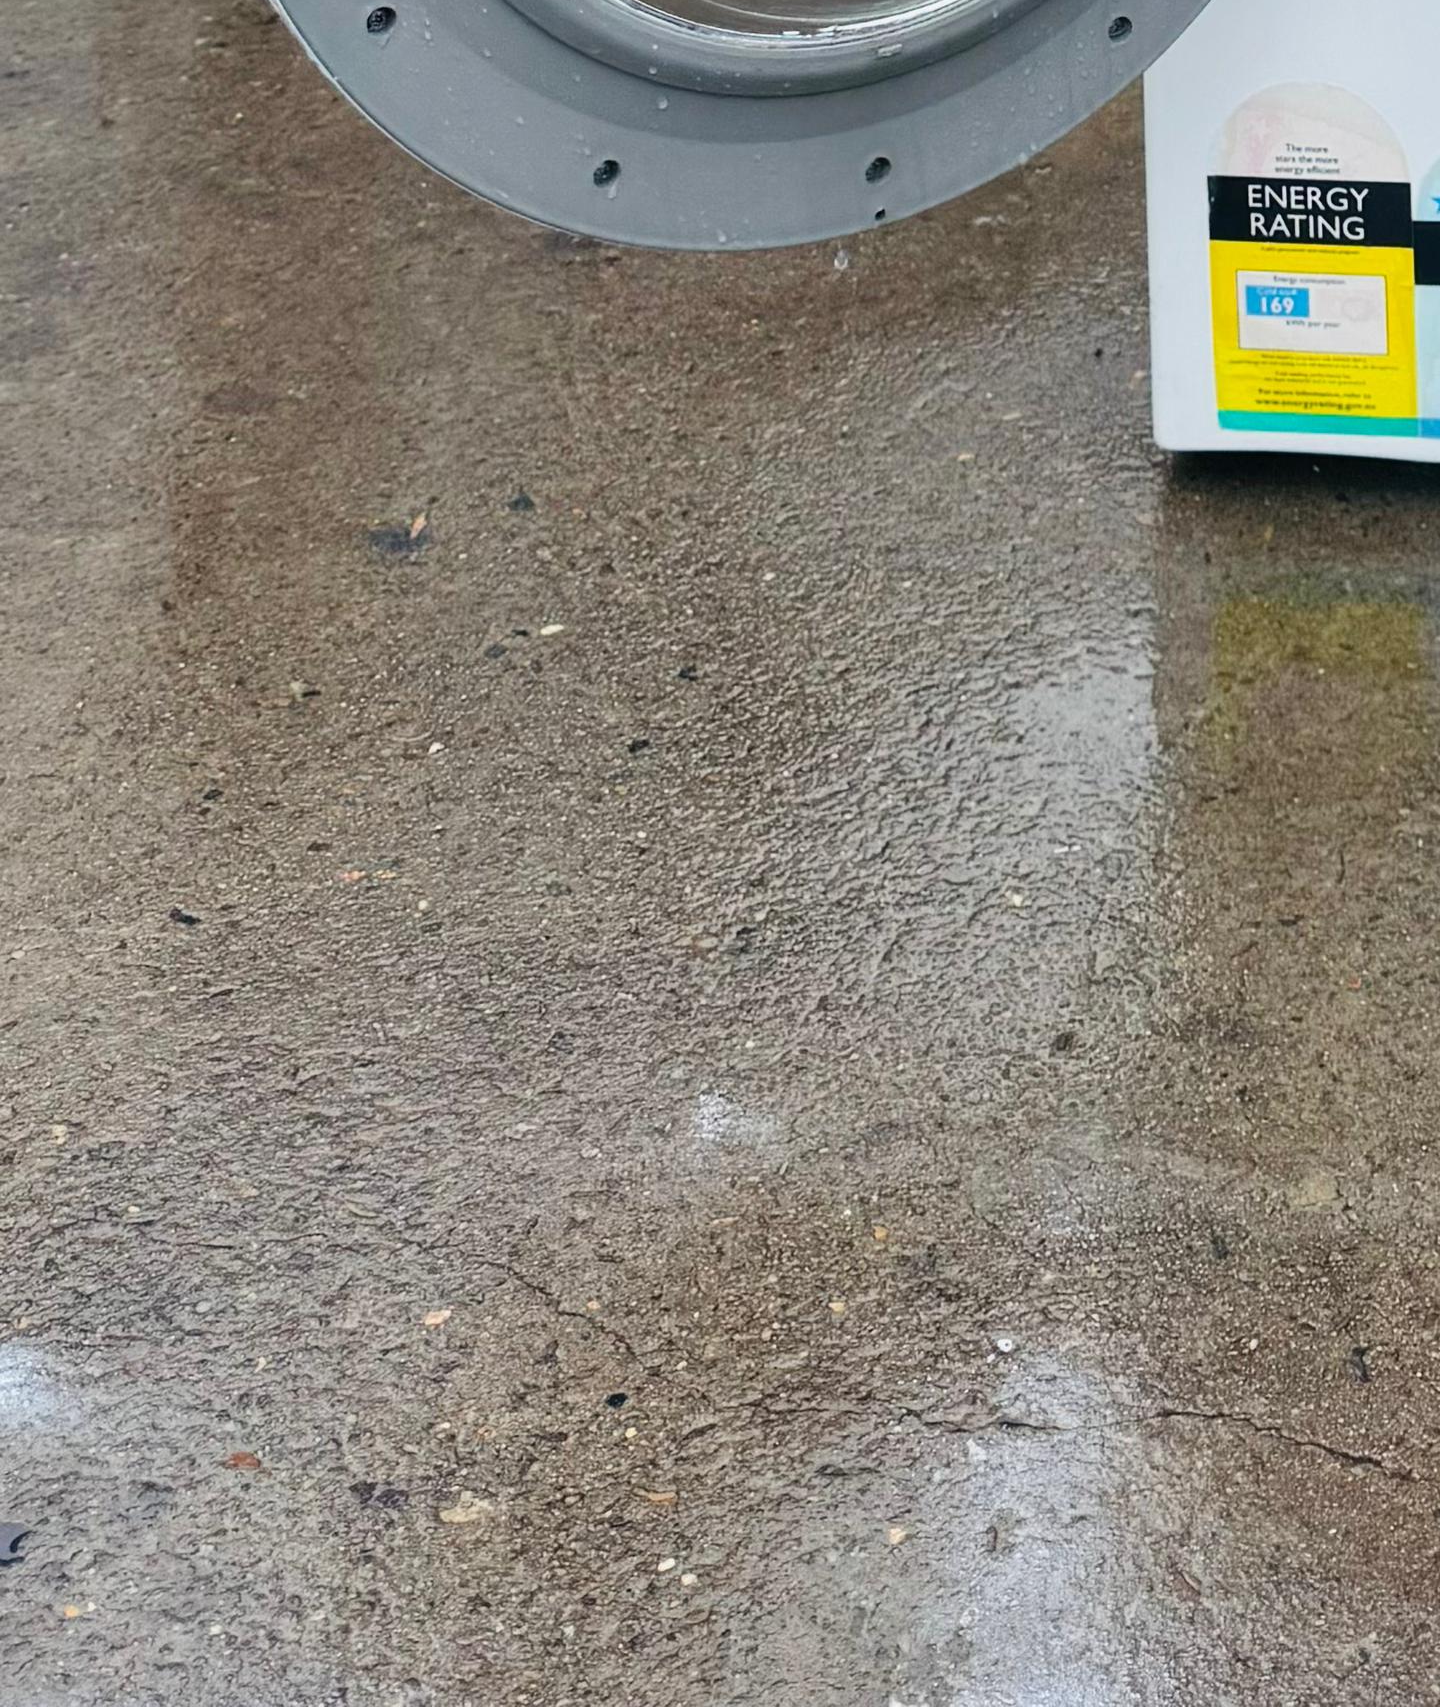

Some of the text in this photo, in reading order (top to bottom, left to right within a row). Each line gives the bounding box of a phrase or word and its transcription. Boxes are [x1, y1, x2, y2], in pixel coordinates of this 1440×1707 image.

[1286, 143, 1302, 152] The
[1275, 165, 1340, 175] energy efficient
[1247, 184, 1369, 212] ENERGY
[1250, 212, 1365, 240] RATING
[1261, 297, 1294, 314] 169
